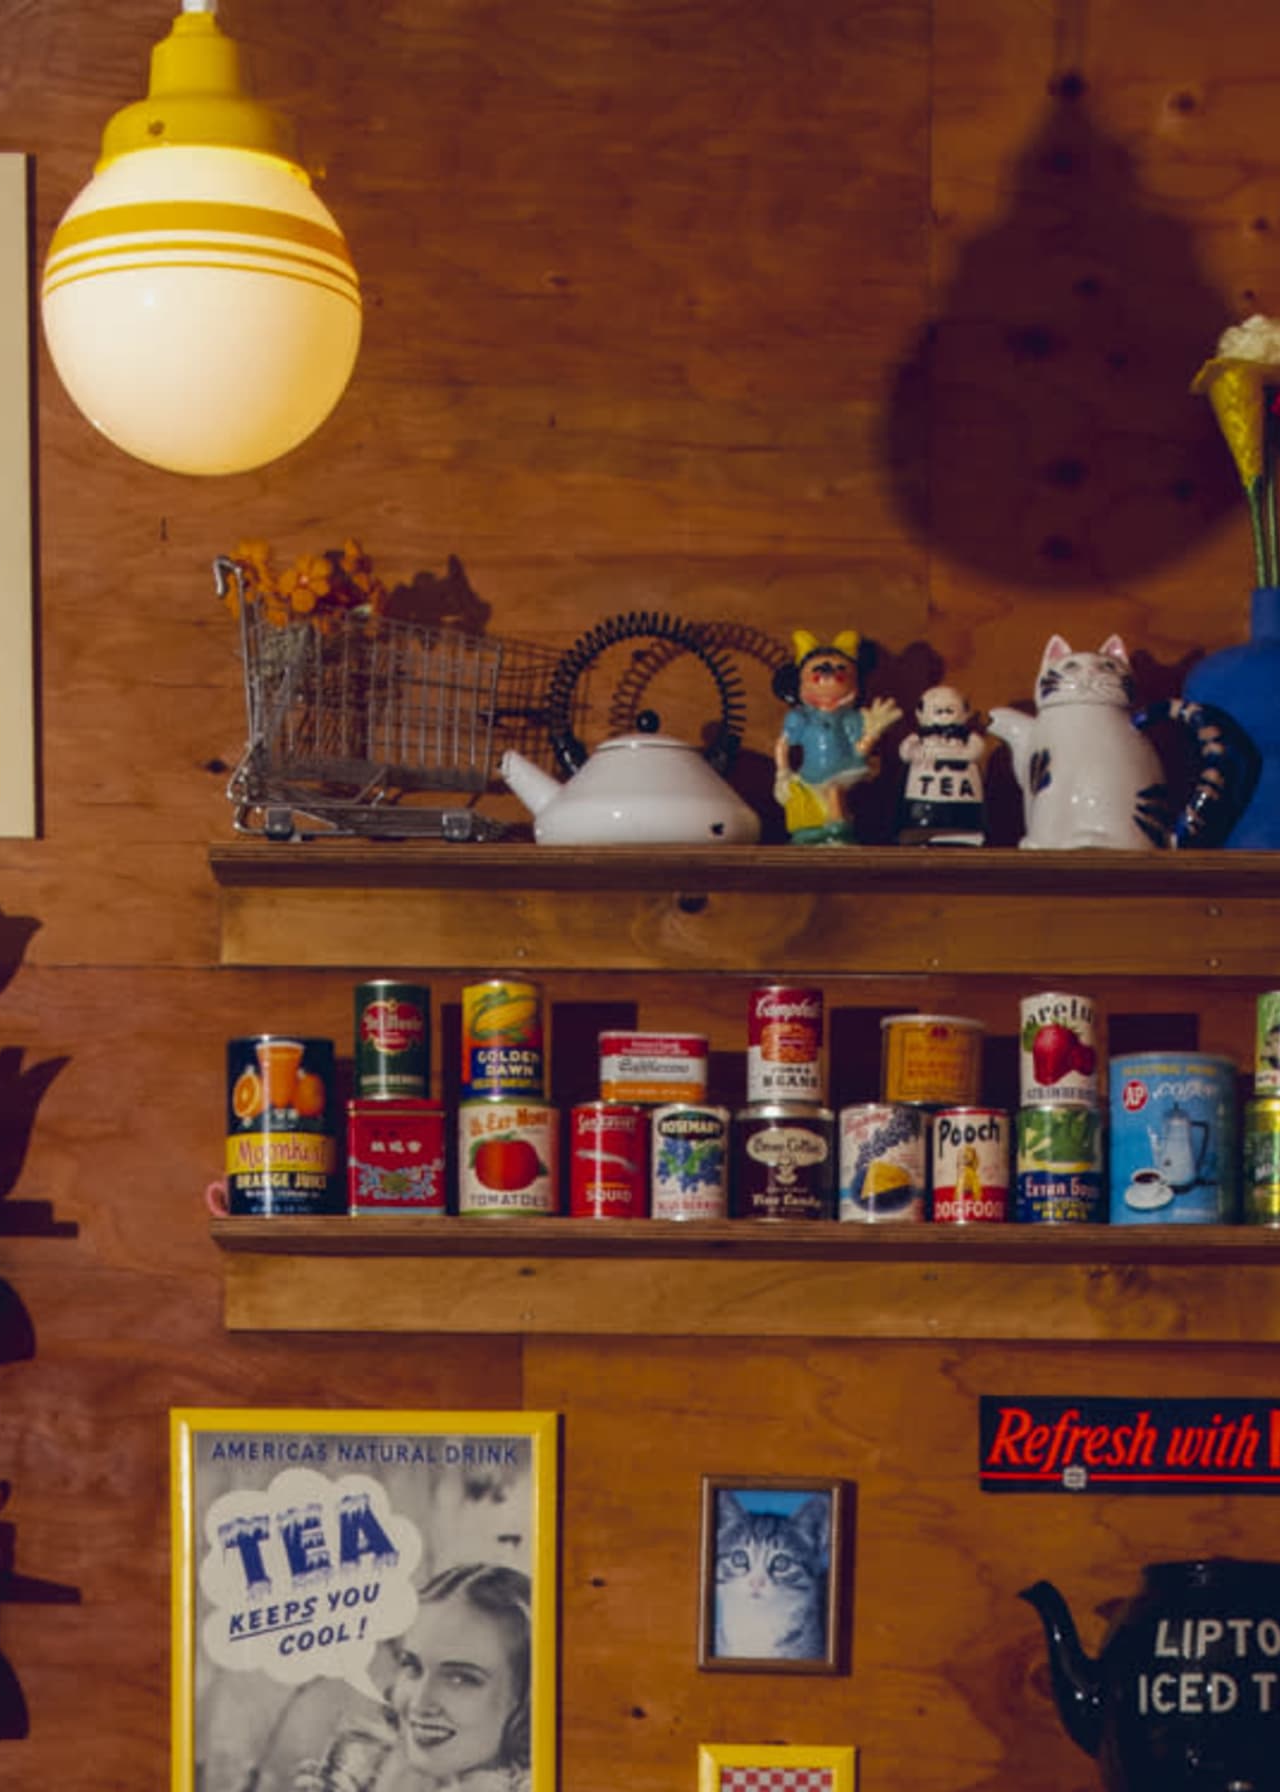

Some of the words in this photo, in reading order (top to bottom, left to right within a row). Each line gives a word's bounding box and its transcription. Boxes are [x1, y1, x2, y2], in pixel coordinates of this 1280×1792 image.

[918, 776, 975, 797] TEA
[485, 1065, 534, 1077] DAWN
[939, 1119, 1000, 1159] Pooch
[337, 1442, 438, 1463] NATURAL
[445, 1445, 519, 1465] DRINK
[986, 1407, 1158, 1473] Refresh
[1166, 1413, 1261, 1468] with
[218, 1493, 400, 1602] TEA
[229, 1596, 319, 1635] KEEPS
[327, 1583, 381, 1611] YOU
[1138, 1673, 1238, 1715] ICED
